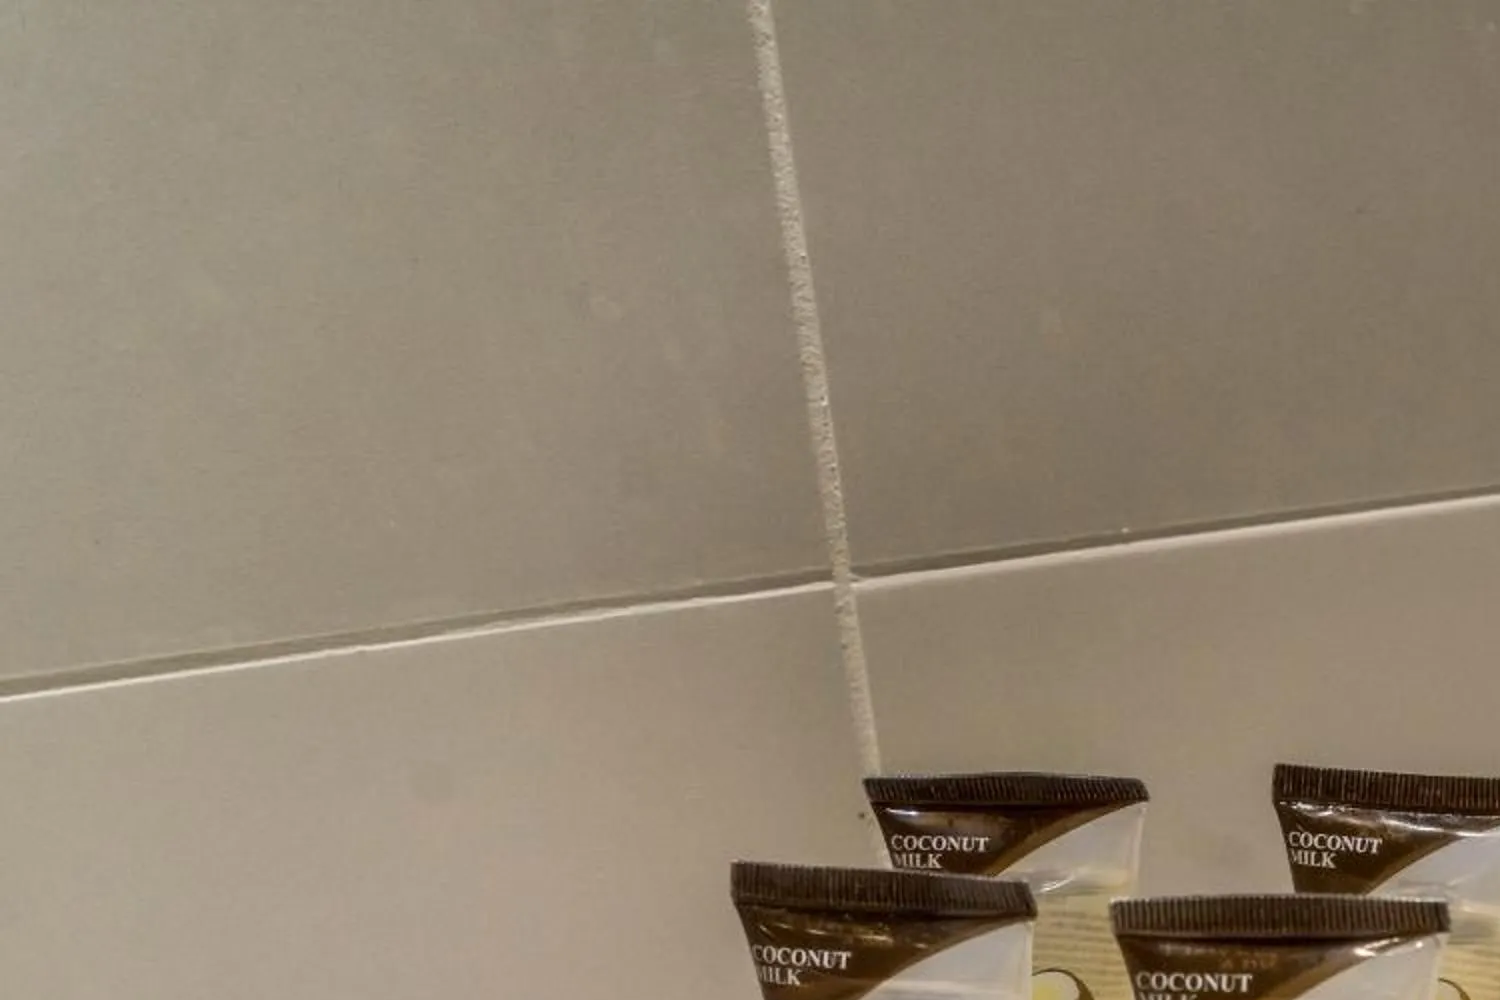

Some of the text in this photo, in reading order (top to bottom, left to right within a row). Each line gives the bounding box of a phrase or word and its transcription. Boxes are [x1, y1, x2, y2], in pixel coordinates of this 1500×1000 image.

[891, 833, 990, 853] COCONUT
[1288, 831, 1383, 854] COCONUT
[893, 852, 943, 869] MILK
[1290, 848, 1338, 869] MILK
[752, 944, 852, 970] COCONUT
[1136, 971, 1253, 993] COCONUT
